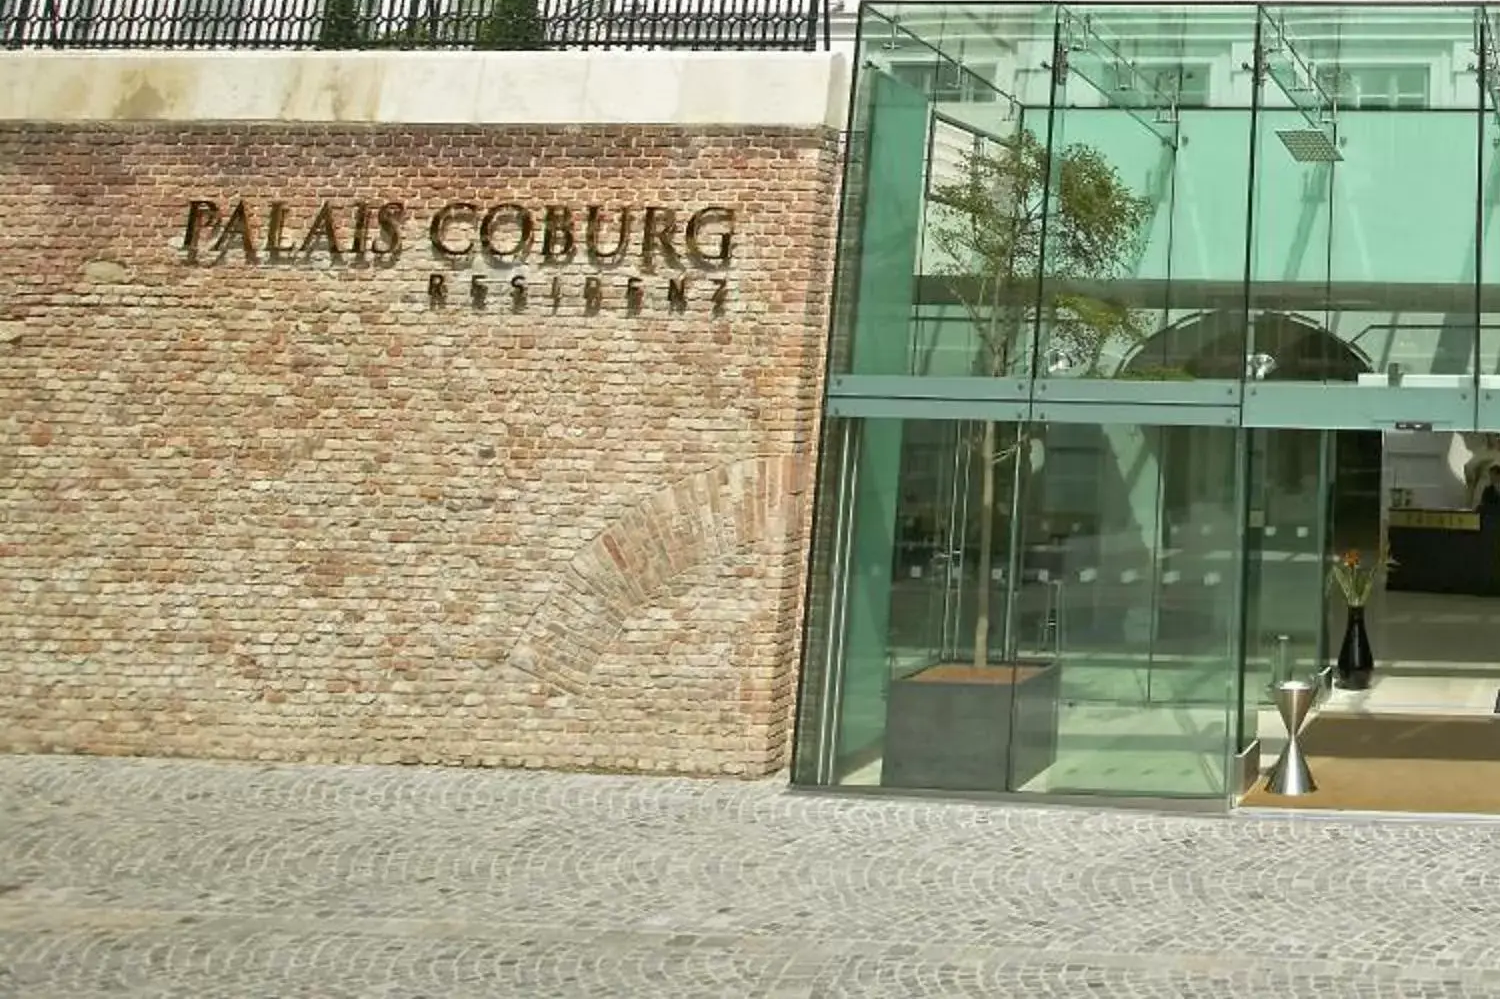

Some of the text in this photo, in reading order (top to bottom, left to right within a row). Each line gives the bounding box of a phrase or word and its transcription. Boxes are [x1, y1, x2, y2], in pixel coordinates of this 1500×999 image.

[184, 200, 735, 260] PALAIS COBURG
[427, 273, 728, 309] RESIDENZ
